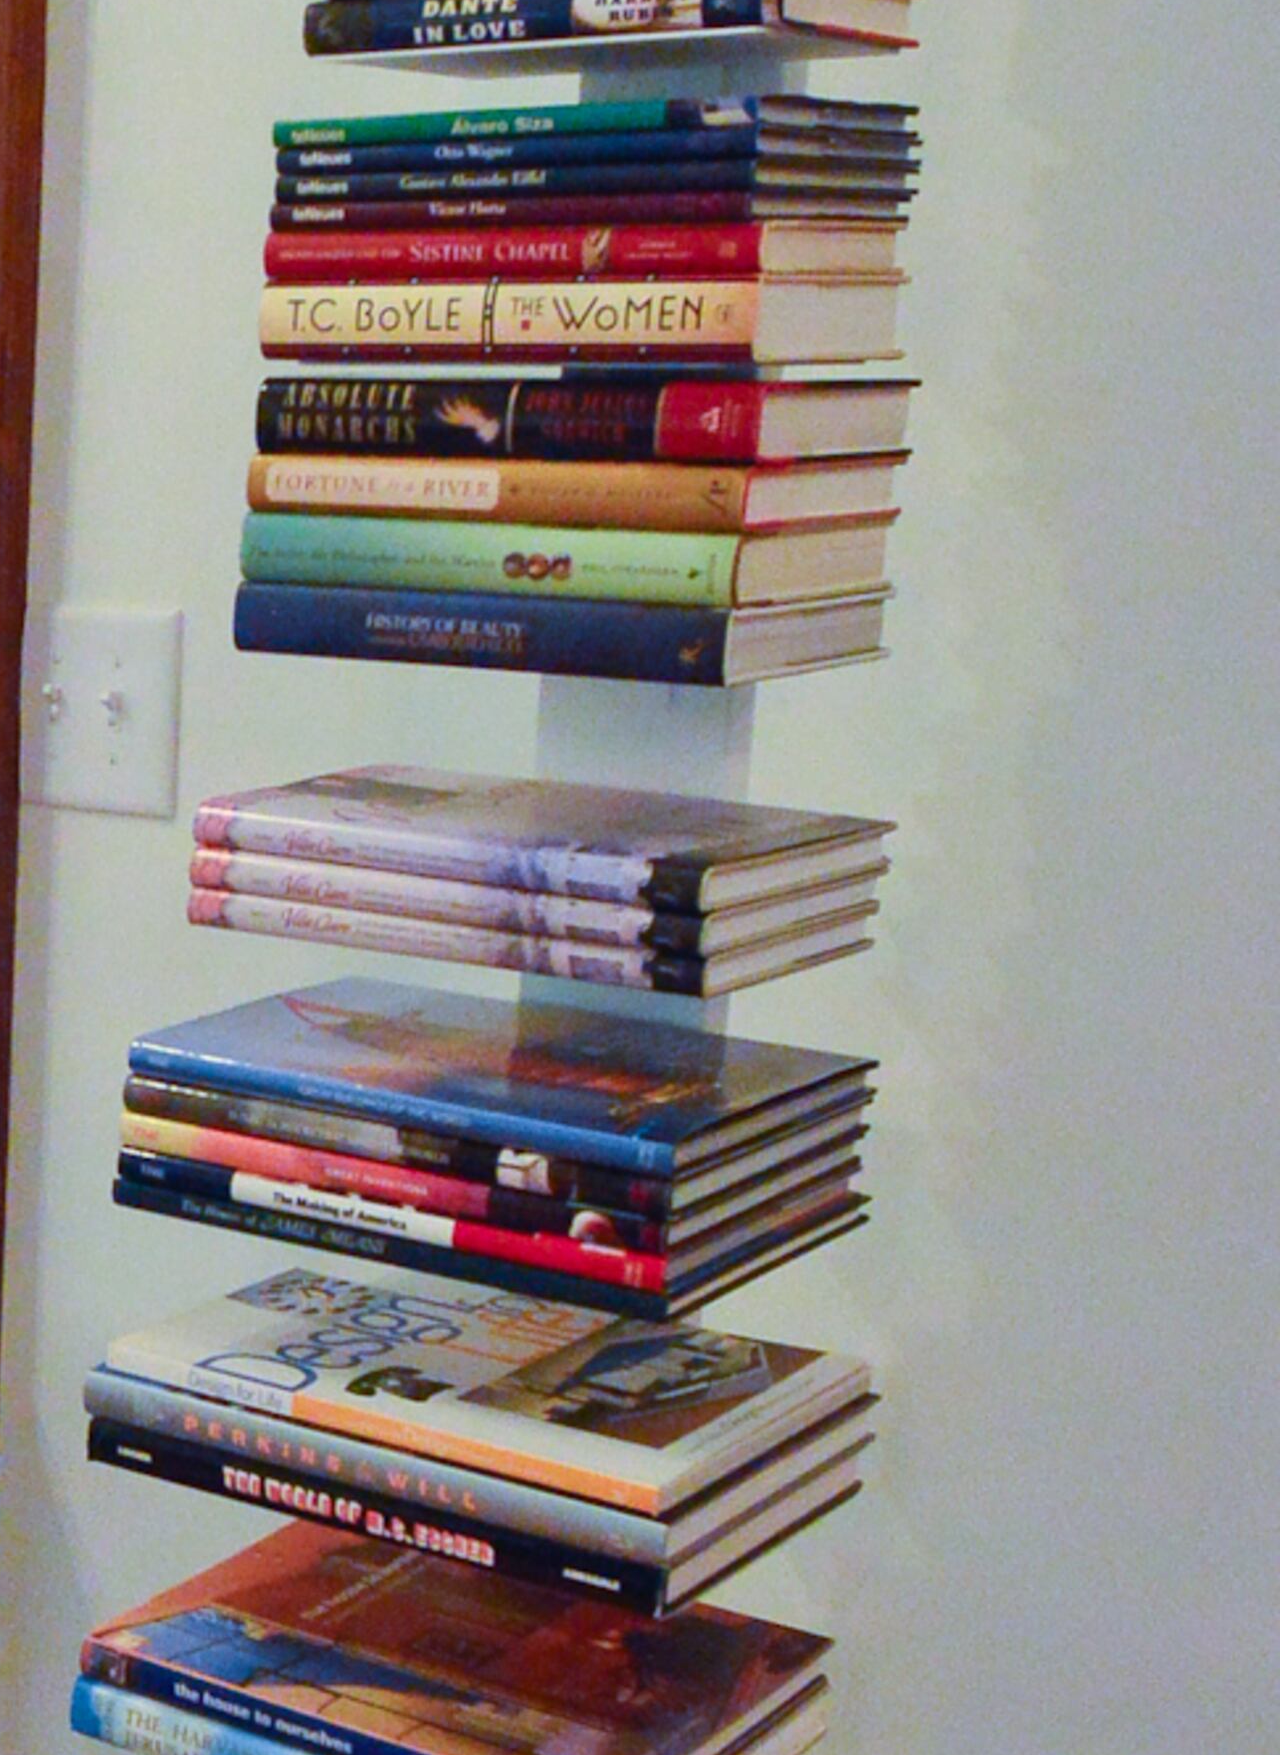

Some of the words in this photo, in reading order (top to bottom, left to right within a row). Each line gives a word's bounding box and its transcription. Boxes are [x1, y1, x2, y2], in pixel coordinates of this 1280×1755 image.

[607, 5, 673, 23] RUBIN
[412, 23, 448, 45] IN
[453, 18, 527, 43] LOVE
[514, 115, 554, 132] Siza
[409, 242, 484, 263] SISTINE
[494, 242, 569, 262] CHAPEL
[287, 298, 341, 333] T.C.
[511, 296, 545, 316] THE
[282, 383, 417, 411] ABSOLUTE
[277, 412, 417, 443] MONARCHS
[274, 472, 377, 495] FORTUNE
[423, 477, 492, 500] RIVER
[365, 610, 431, 633] HISTORY
[434, 615, 454, 634] OF
[458, 617, 525, 638] BEAUTY
[274, 1191, 293, 1207] The
[297, 1195, 339, 1216] Making
[342, 1206, 355, 1219] of
[358, 1210, 407, 1231] America
[193, 1293, 464, 1393] Design
[183, 1412, 341, 1474] PERKINS
[387, 1470, 478, 1513] WILL
[222, 1464, 261, 1497] THE
[264, 1475, 333, 1518] WORLD
[335, 1496, 362, 1526] OF
[126, 1707, 161, 1735] THE
[174, 1681, 199, 1704] the
[203, 1690, 251, 1721] house
[254, 1706, 272, 1725] to
[275, 1713, 354, 1755] ourselves
